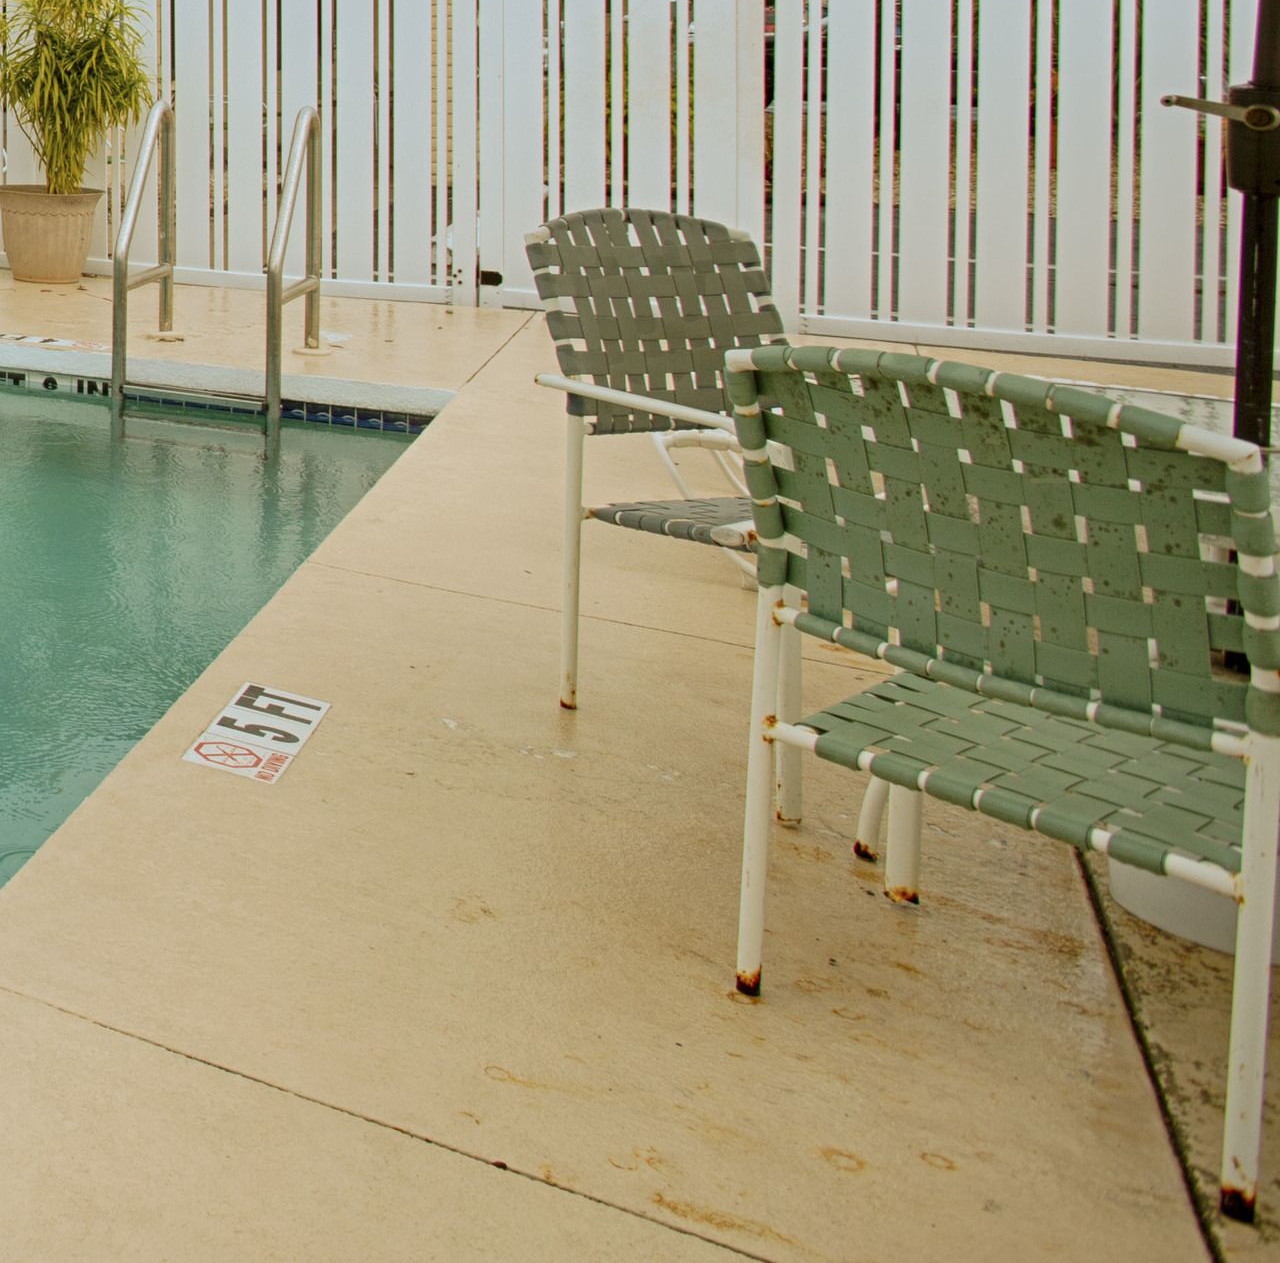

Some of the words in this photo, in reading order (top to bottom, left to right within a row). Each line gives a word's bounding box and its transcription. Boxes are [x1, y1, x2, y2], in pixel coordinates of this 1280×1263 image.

[77, 378, 109, 397] IN
[234, 684, 322, 725] FT
[216, 715, 300, 744] 5
